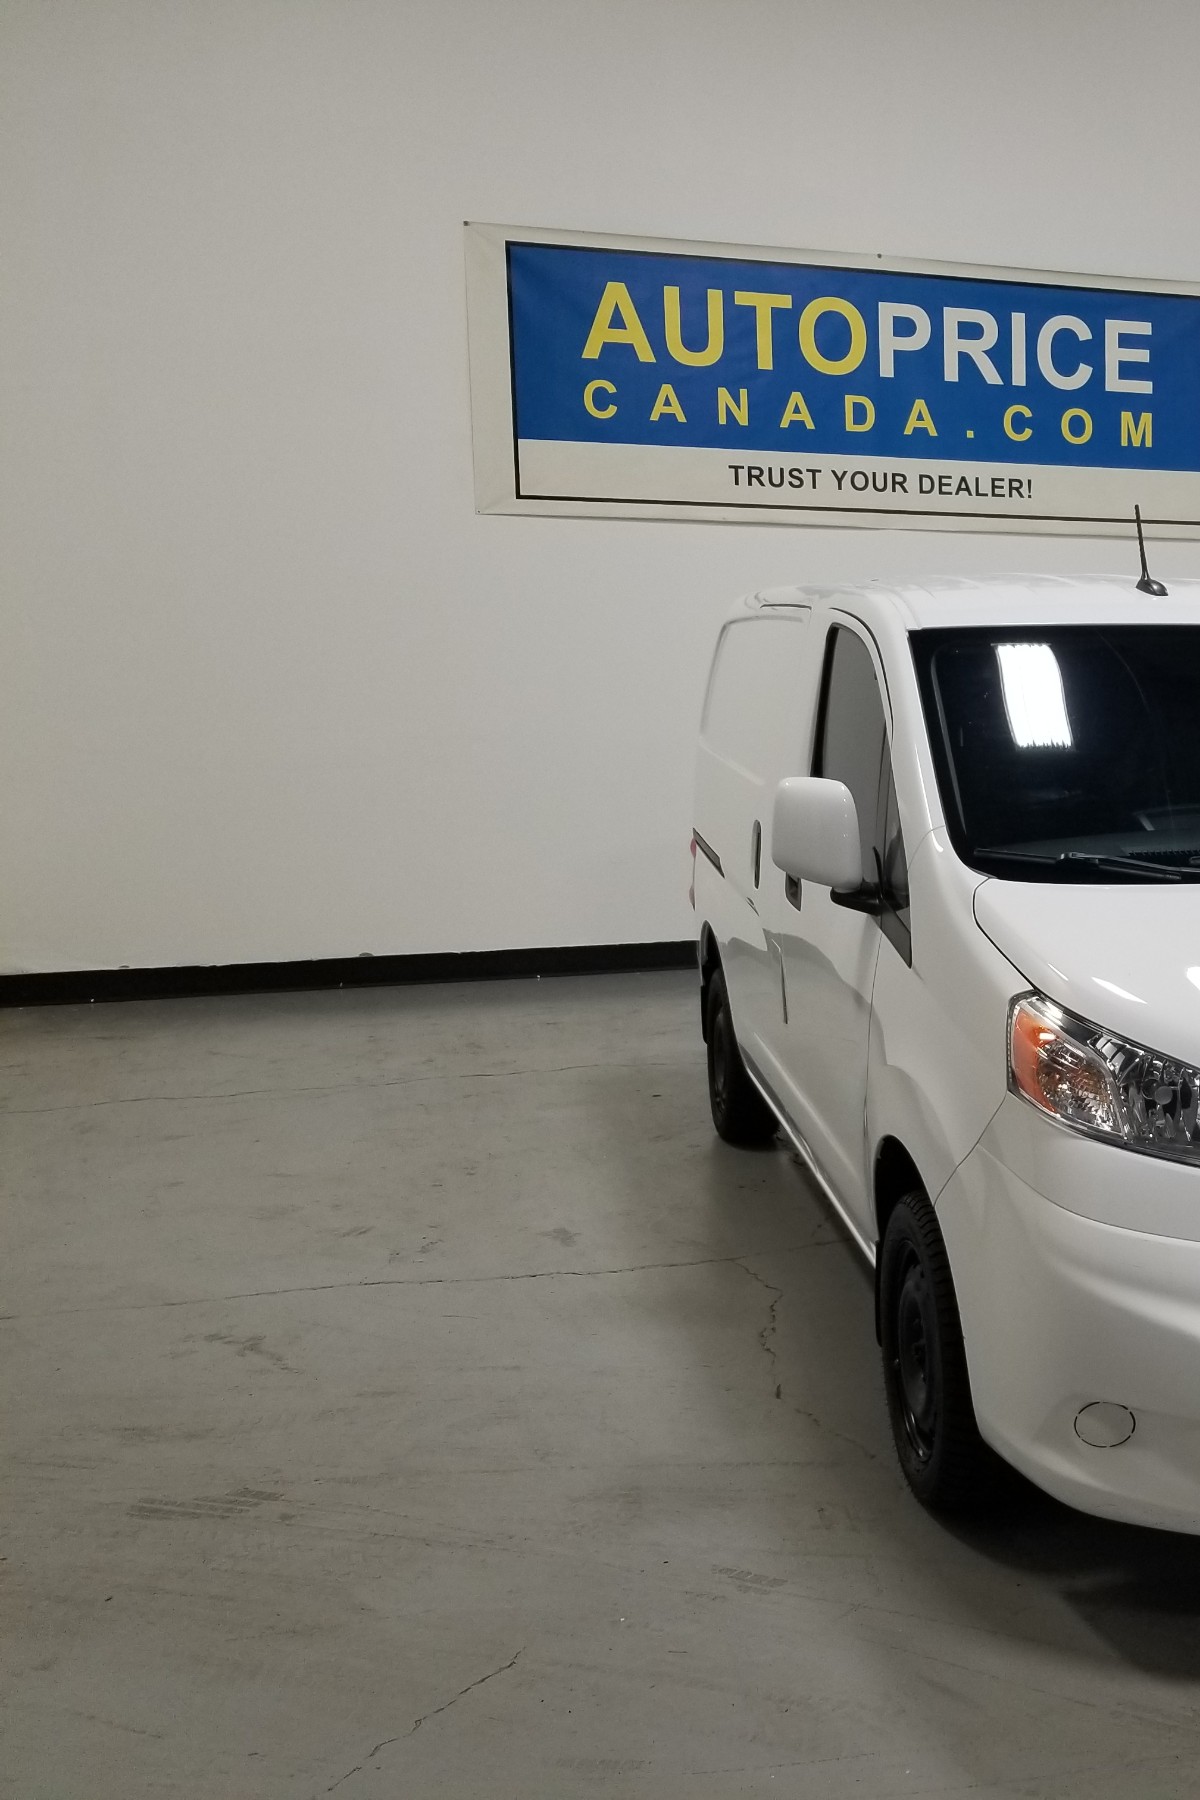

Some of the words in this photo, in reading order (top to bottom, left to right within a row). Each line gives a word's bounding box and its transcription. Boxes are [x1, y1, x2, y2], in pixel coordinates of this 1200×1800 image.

[581, 281, 1154, 395] AUTOPRICE
[583, 379, 1153, 448] CANADA.COM
[728, 464, 822, 490] TRUST
[830, 469, 909, 494] YOUR
[918, 473, 1033, 499] DEALER!
